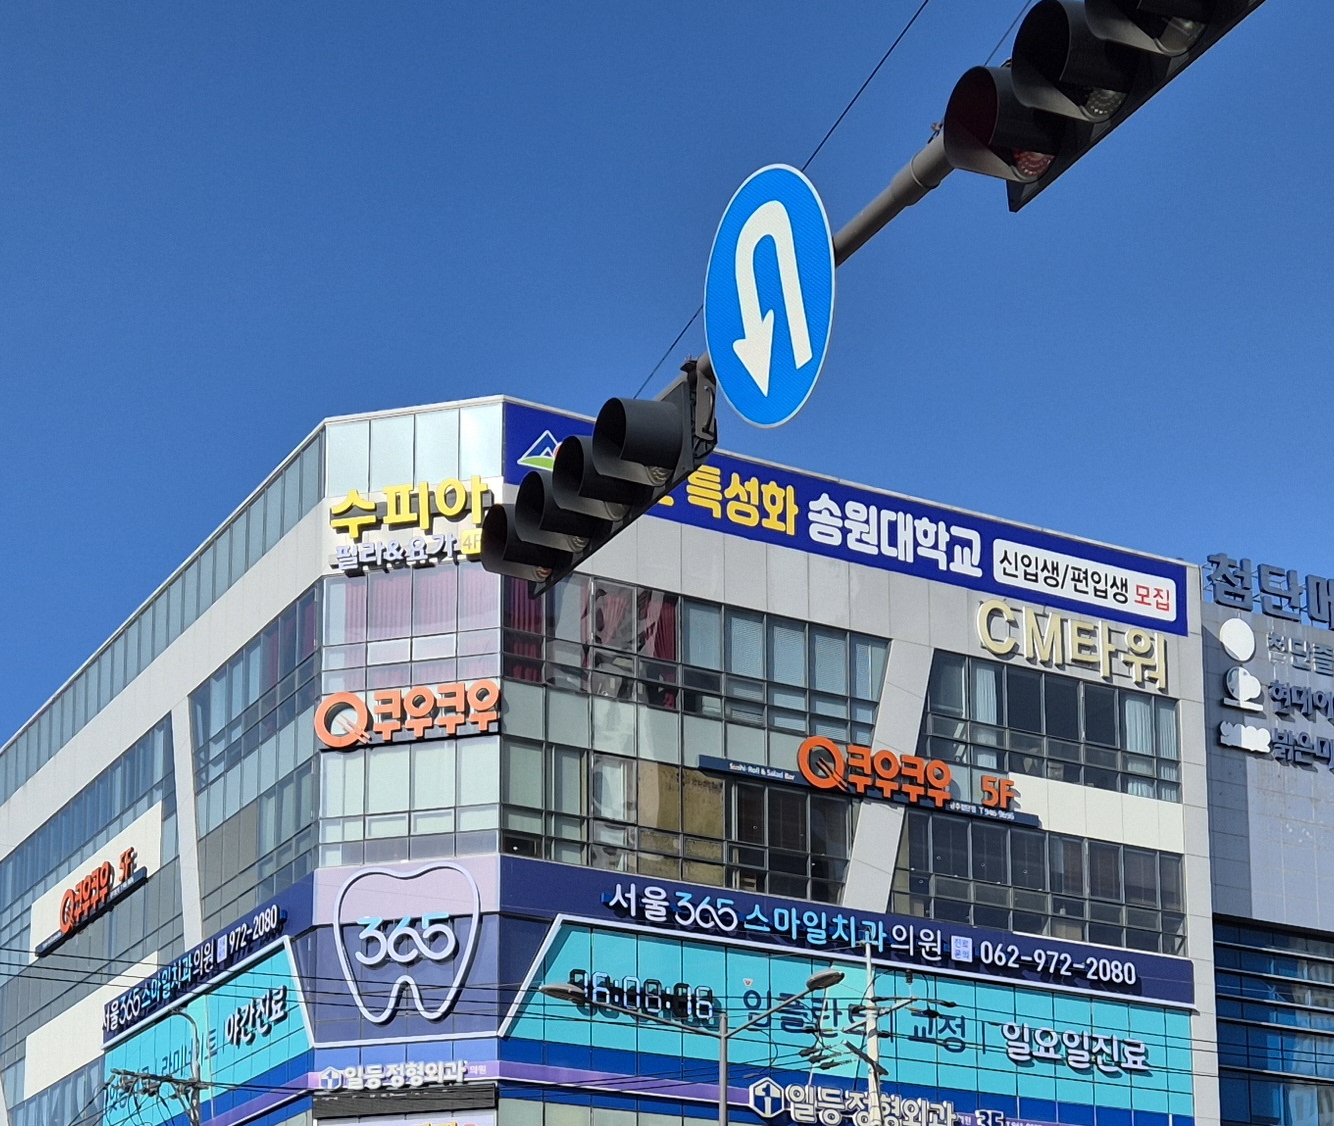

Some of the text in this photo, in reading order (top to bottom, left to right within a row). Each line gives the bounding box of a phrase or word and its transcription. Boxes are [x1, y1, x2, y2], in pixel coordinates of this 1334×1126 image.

[329, 475, 490, 538] 수피아
[687, 464, 1171, 612] 특성화 송원대학교 신입생/편입생 모집
[977, 599, 1167, 690] CM타워
[981, 775, 1015, 809] 5F
[228, 905, 278, 954] 972-2080
[355, 912, 459, 965] 365
[608, 882, 669, 917] 서울
[674, 889, 738, 933] 365
[979, 940, 1137, 985] 062-972-2080
[225, 984, 288, 1048] 야간진료
[907, 1010, 966, 1053] 교정
[1001, 1021, 1151, 1074] 일요일진료
[344, 1059, 467, 1090] 일등정형외과
